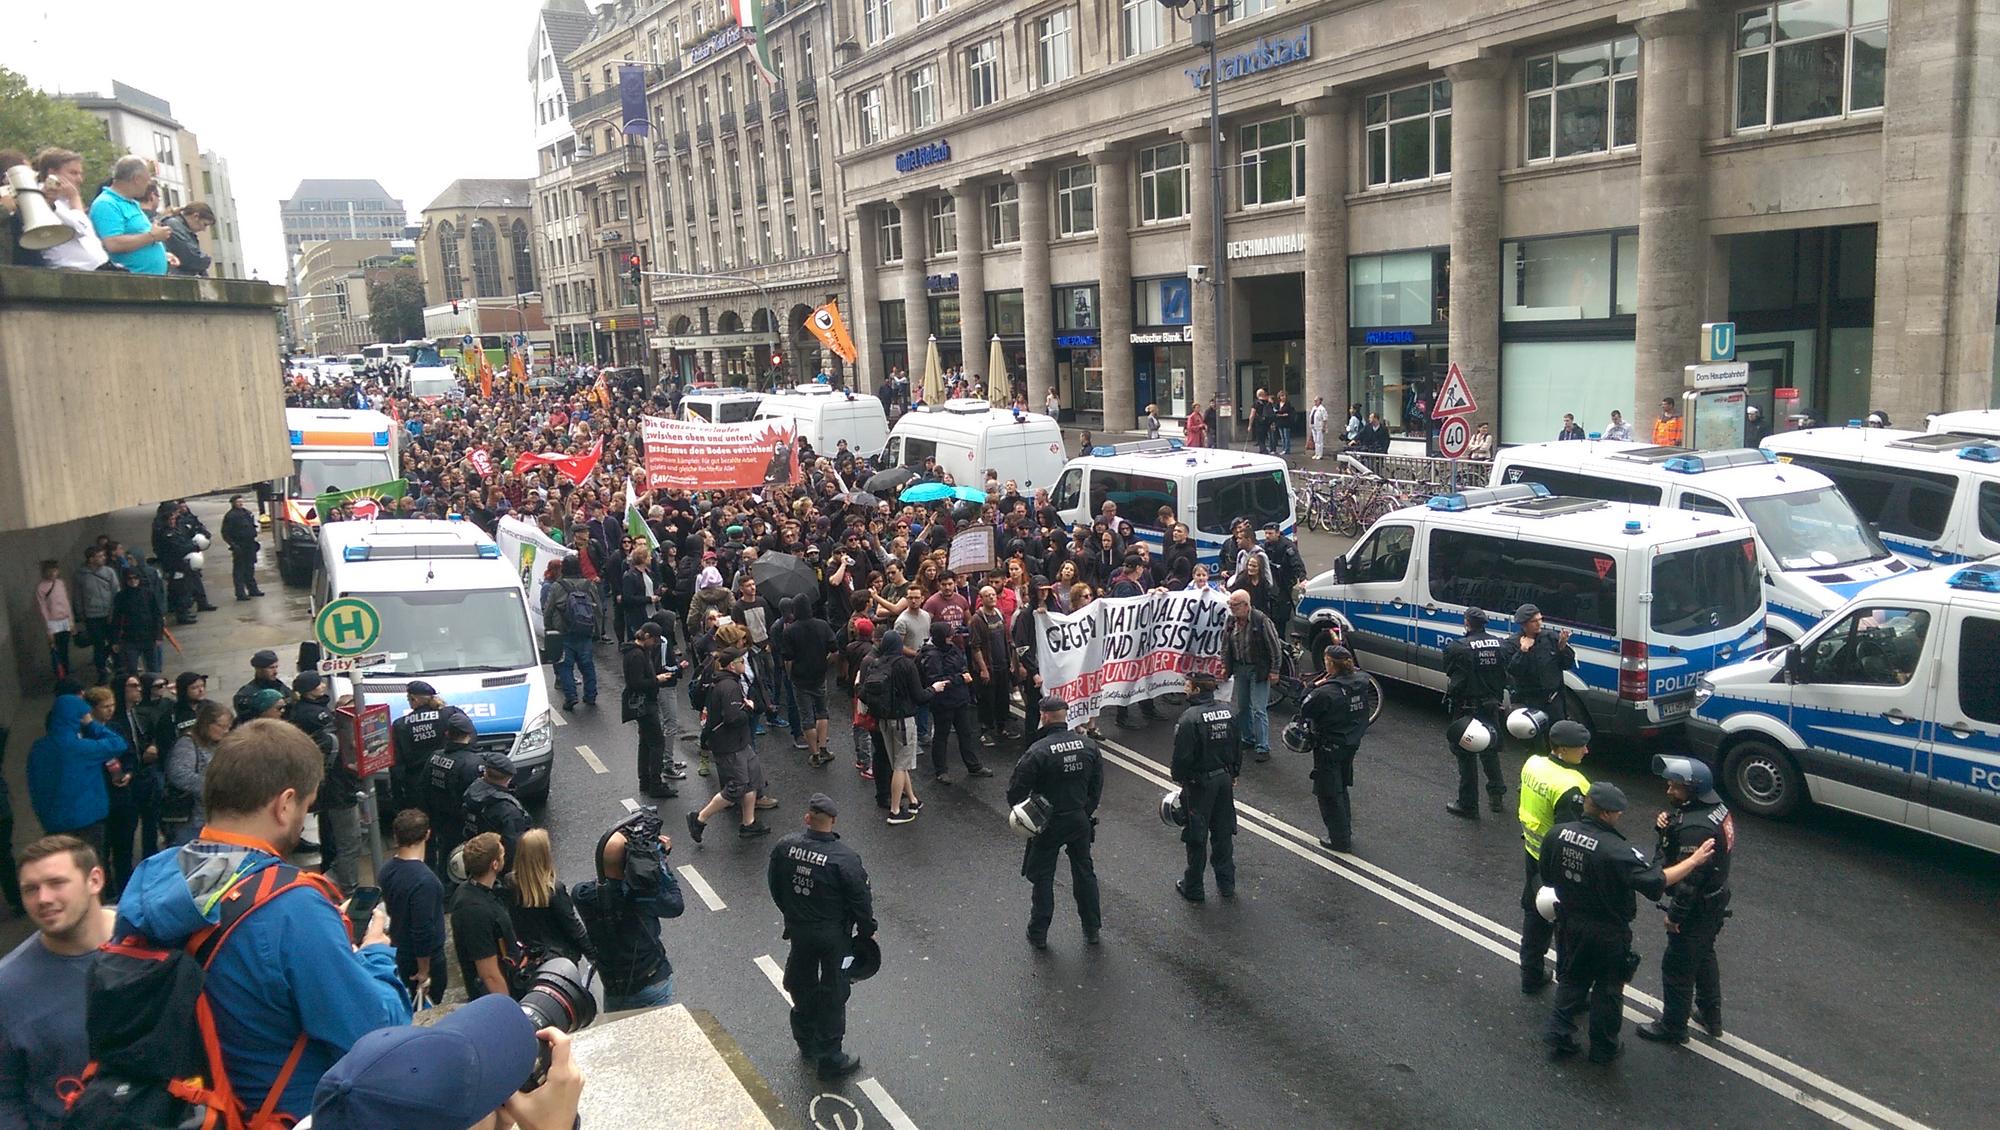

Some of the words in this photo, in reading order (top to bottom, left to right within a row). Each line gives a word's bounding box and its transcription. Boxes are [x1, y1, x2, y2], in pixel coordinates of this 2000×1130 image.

[1216, 24, 1311, 81] randstad
[1227, 233, 1305, 259] DEICHMANNHAU
[1130, 333, 1162, 343] Deutsche
[1163, 332, 1182, 343] Bank
[1716, 328, 1730, 355] U
[1696, 373, 1709, 381] Dom
[645, 420, 658, 428] Die
[647, 431, 683, 441] zwischen
[686, 433, 705, 442] oben
[707, 434, 723, 442] und
[725, 433, 752, 442] unten!
[1446, 427, 1464, 447] 40
[332, 610, 365, 644] H
[1046, 614, 1097, 653] GEGEN
[1470, 639, 1500, 649] POLIZEI
[322, 661, 352, 672] City
[1655, 671, 1705, 694] POLIZE
[404, 711, 440, 724] POLIZEI
[1202, 710, 1231, 722] POLIZEI
[412, 724, 433, 734] NRW
[413, 730, 437, 742] 21633
[1050, 740, 1084, 754] POLIZEI
[430, 755, 455, 770] POLIZEI
[1558, 828, 1599, 851] POLIZEI
[788, 846, 828, 867] POLIZEI
[1562, 846, 1584, 861] NRW
[796, 865, 812, 876] NRW
